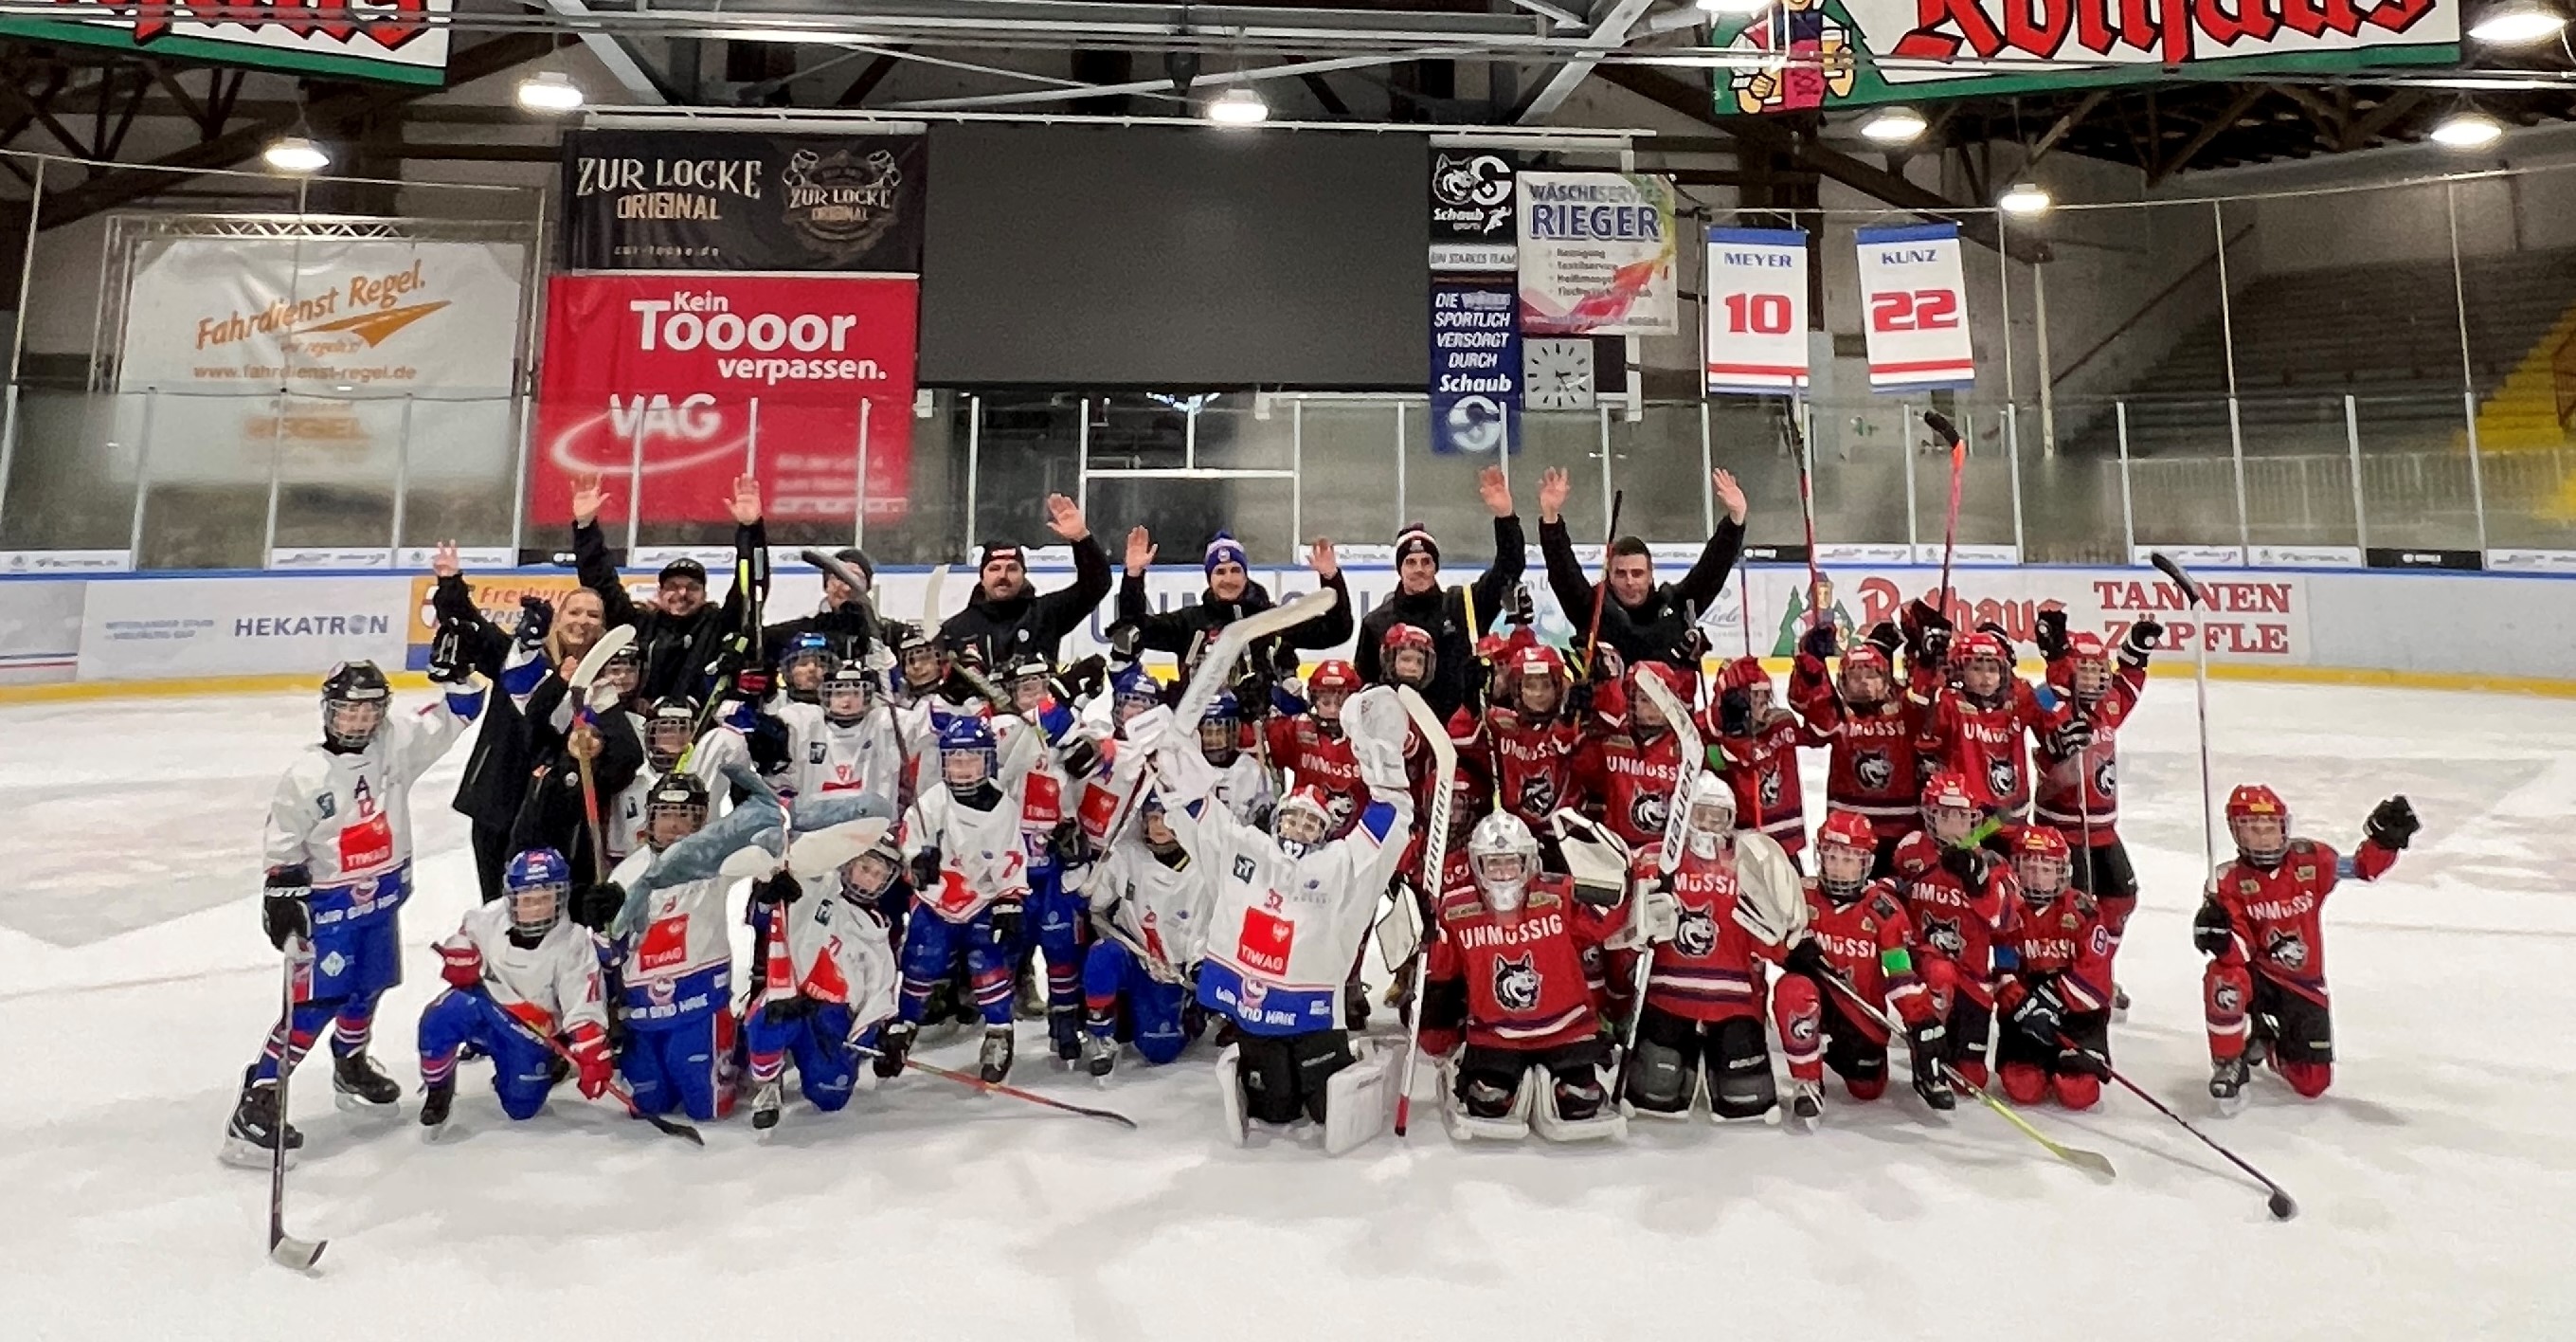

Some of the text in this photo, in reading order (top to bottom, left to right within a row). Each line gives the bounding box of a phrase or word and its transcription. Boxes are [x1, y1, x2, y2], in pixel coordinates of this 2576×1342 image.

[576, 156, 763, 200] ZUR LOCKE
[617, 191, 722, 221] ORIGINAL
[789, 189, 892, 209] ZUR LOCKE
[1530, 203, 1661, 238] RIEGER
[1723, 252, 1792, 268] MEYER
[1881, 248, 1938, 265] KUNZ
[195, 258, 426, 351] Fahrdienst Regel.
[674, 290, 729, 313] Kein
[1435, 292, 1459, 308] DIE
[1871, 288, 1959, 334] 22
[629, 299, 857, 353] Toooor
[1433, 311, 1511, 328] SPORTLICH
[1725, 292, 1792, 335] 10
[1437, 331, 1510, 349] VERSORGT
[717, 357, 888, 386] verpassen.
[1449, 352, 1498, 369] DURCH
[1439, 372, 1513, 392] Schaub
[609, 392, 723, 441] VAG
[2093, 580, 2293, 613] TANNEN
[234, 615, 389, 637] HEKATRON
